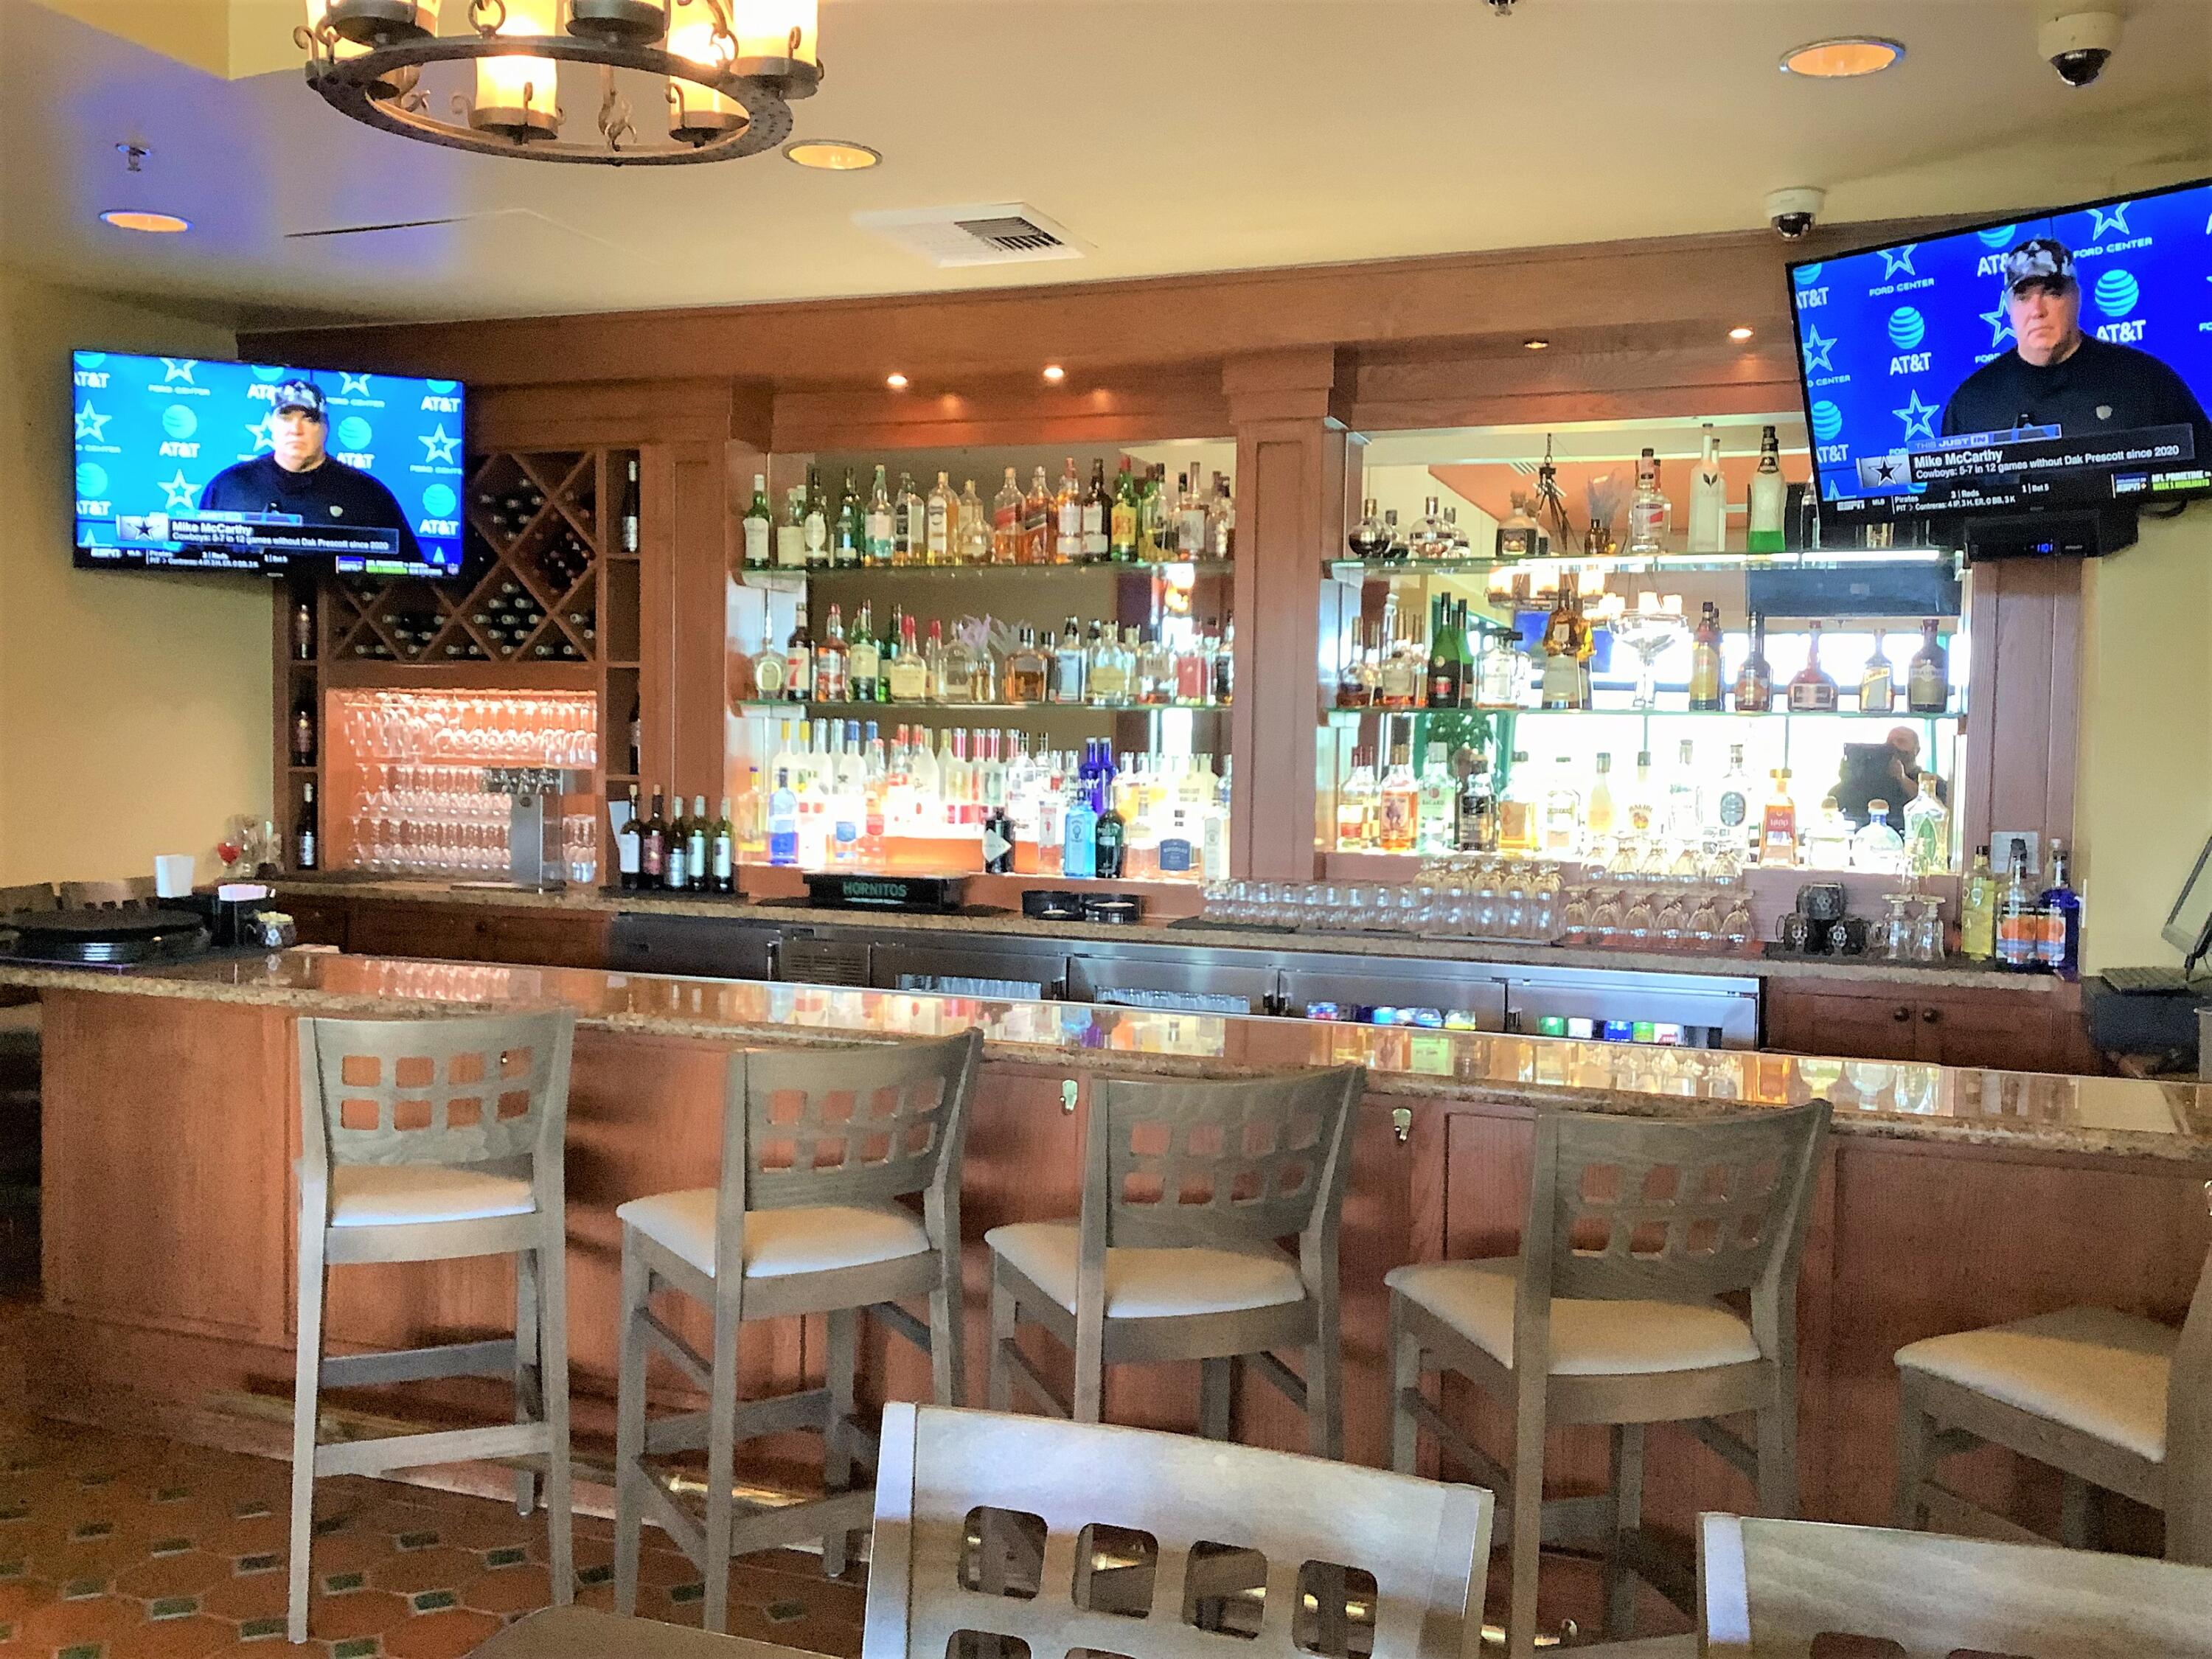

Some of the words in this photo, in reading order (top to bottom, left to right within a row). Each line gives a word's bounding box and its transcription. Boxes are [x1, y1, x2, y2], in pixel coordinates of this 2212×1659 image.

[2073, 246, 2103, 259] FORD
[2106, 237, 2153, 252] CENTER
[1977, 252, 2009, 277] AT&
[1868, 285, 1894, 296] FORD
[1896, 277, 1935, 292] CENTER
[2096, 319, 2146, 343] AT&T
[1890, 352, 1932, 376] AT&T
[1816, 375, 1851, 386] CENTER
[420, 395, 461, 413] AT&T
[159, 441, 201, 459] AT&T
[1938, 437, 1969, 448] JUST
[1914, 455, 1943, 469] Mike
[1944, 450, 2003, 466] McCarthy
[1916, 467, 1958, 480] Cowboys:
[1958, 465, 1973, 475] 5-7
[1975, 464, 1983, 474] in
[1986, 463, 1997, 473] 12
[1997, 460, 2028, 473] games
[2029, 456, 2063, 470] without
[2064, 454, 2084, 466] Dak
[2085, 451, 2125, 464] Prescott
[2126, 448, 2153, 460] since
[2154, 445, 2180, 457] 2020
[1950, 490, 1956, 498] 3
[2022, 484, 2027, 493] 1
[2009, 495, 2016, 504] K
[1837, 499, 1865, 511] ESPN
[172, 521, 199, 533] Mike
[200, 521, 254, 537] McCarthy
[419, 519, 459, 535] AT&T
[235, 535, 245, 544] 12
[787, 658, 804, 687] 7
[842, 881, 907, 897] HORNITOS
